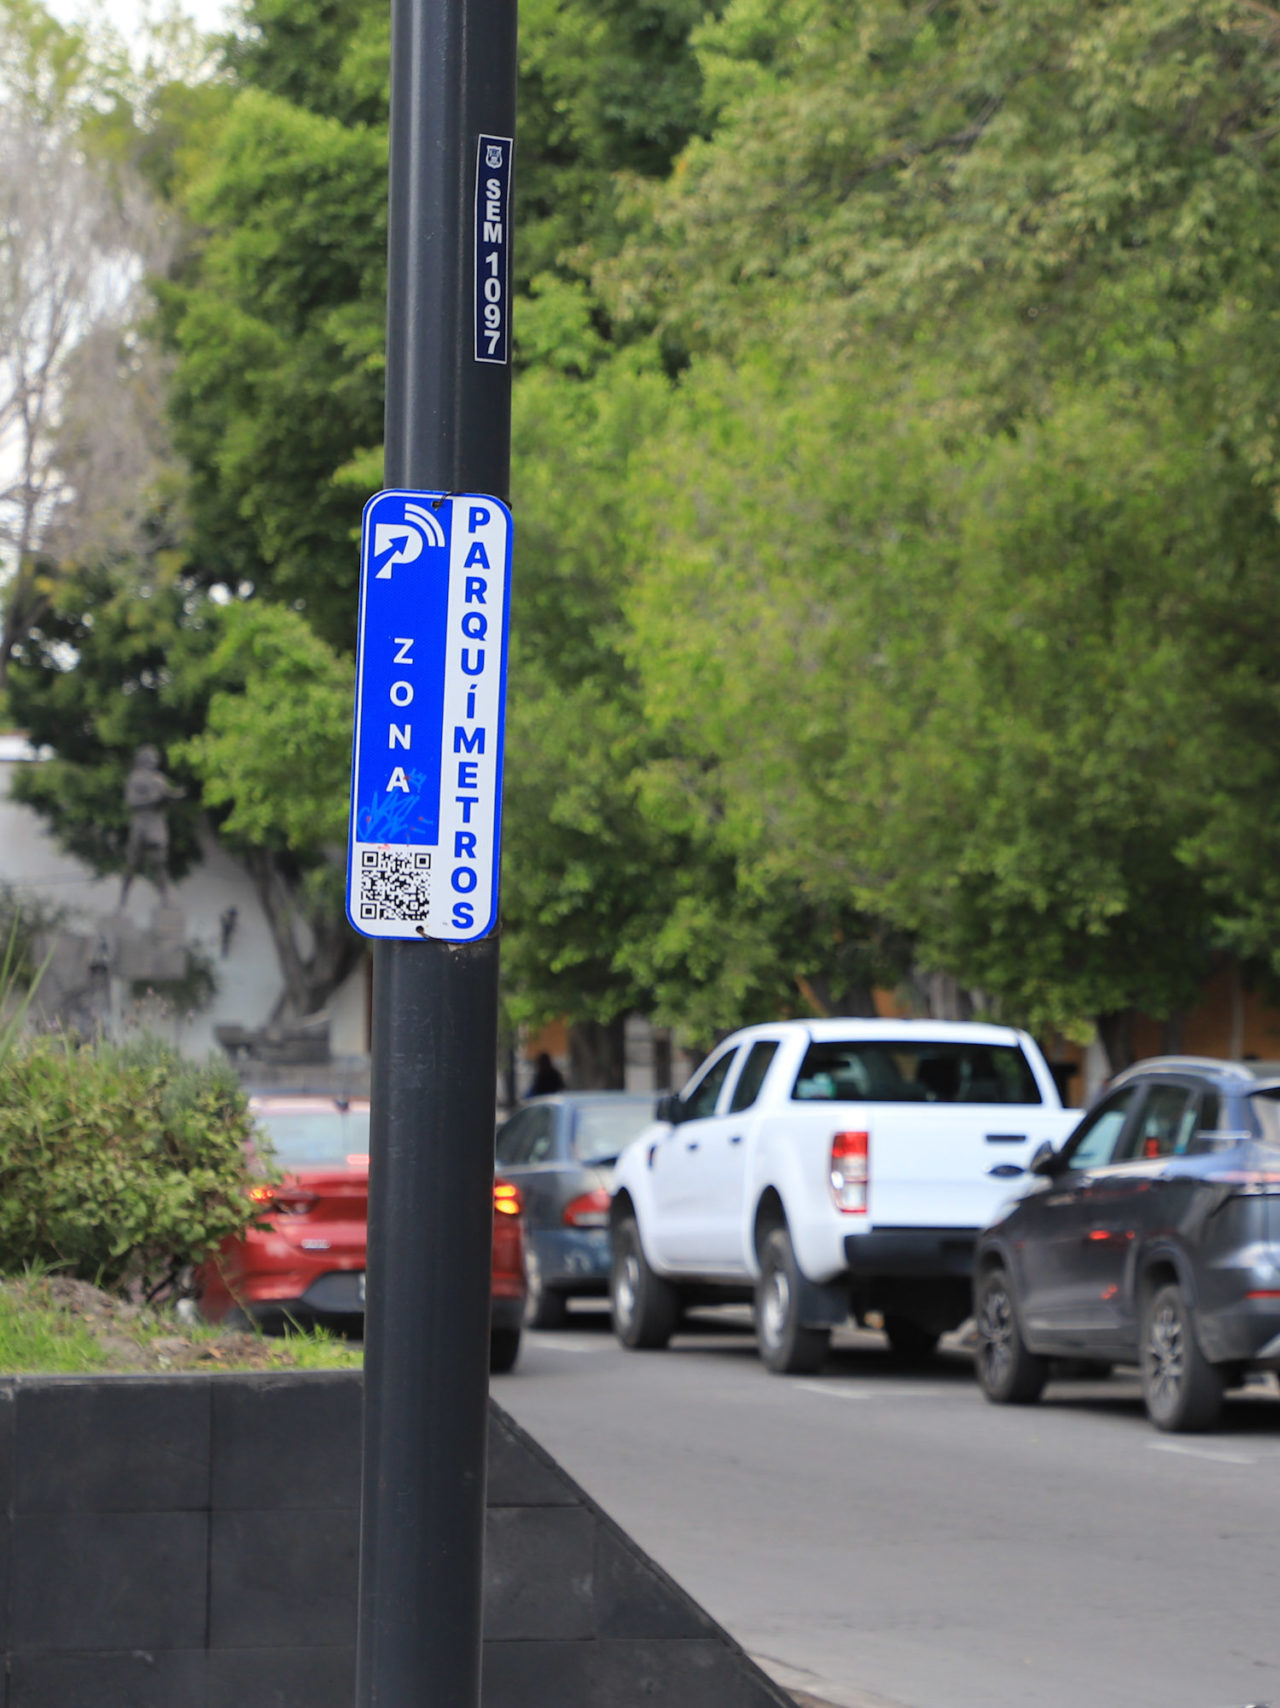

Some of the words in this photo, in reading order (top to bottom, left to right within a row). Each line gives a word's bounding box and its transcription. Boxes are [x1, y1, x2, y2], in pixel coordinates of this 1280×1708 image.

[483, 178, 503, 244] SEM
[484, 251, 502, 355] 1097
[386, 637, 414, 793] ZONA
[451, 506, 491, 930] PARQUÍMETROS
